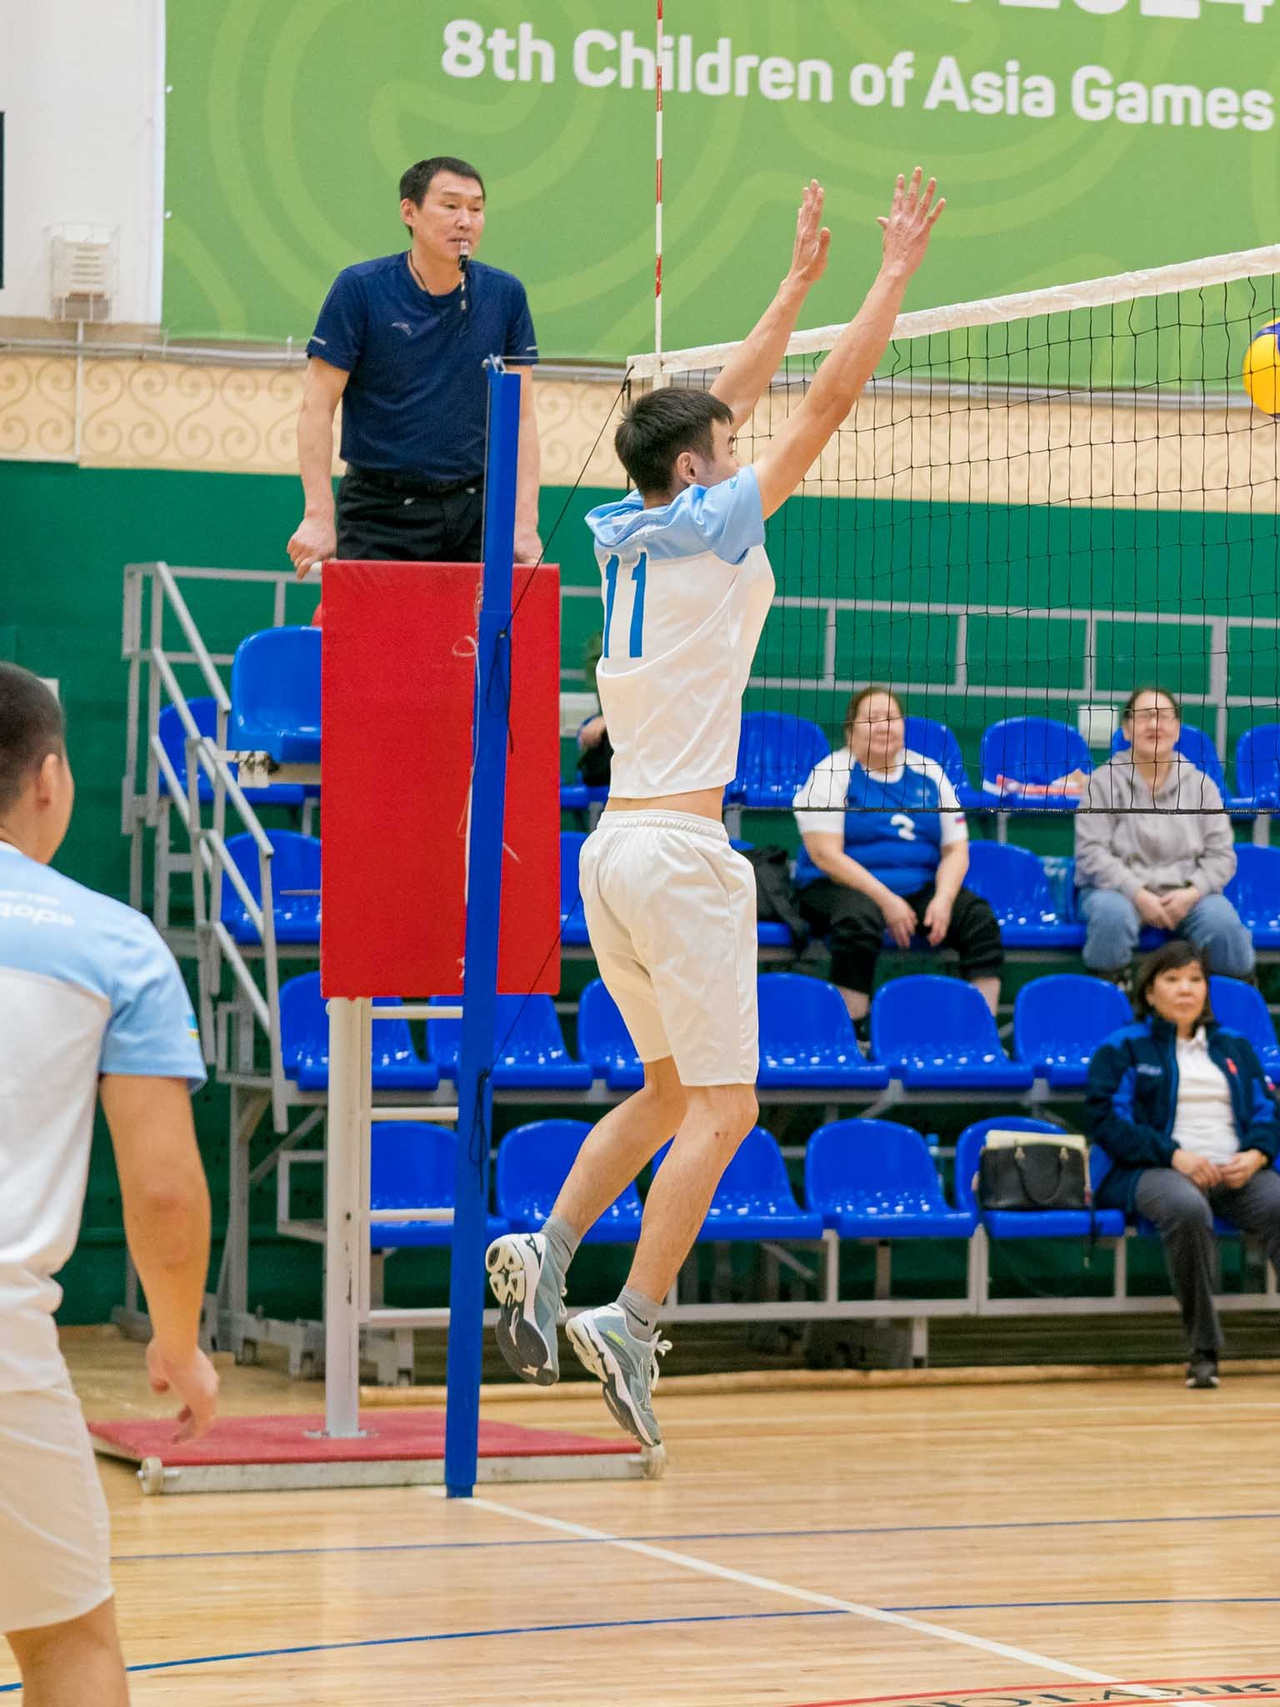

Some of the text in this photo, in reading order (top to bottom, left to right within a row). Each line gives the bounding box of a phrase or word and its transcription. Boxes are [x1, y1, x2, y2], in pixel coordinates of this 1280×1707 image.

[441, 18, 1276, 132] 8th Children of Asia Games
[603, 551, 648, 659] 11
[890, 814, 917, 841] 2
